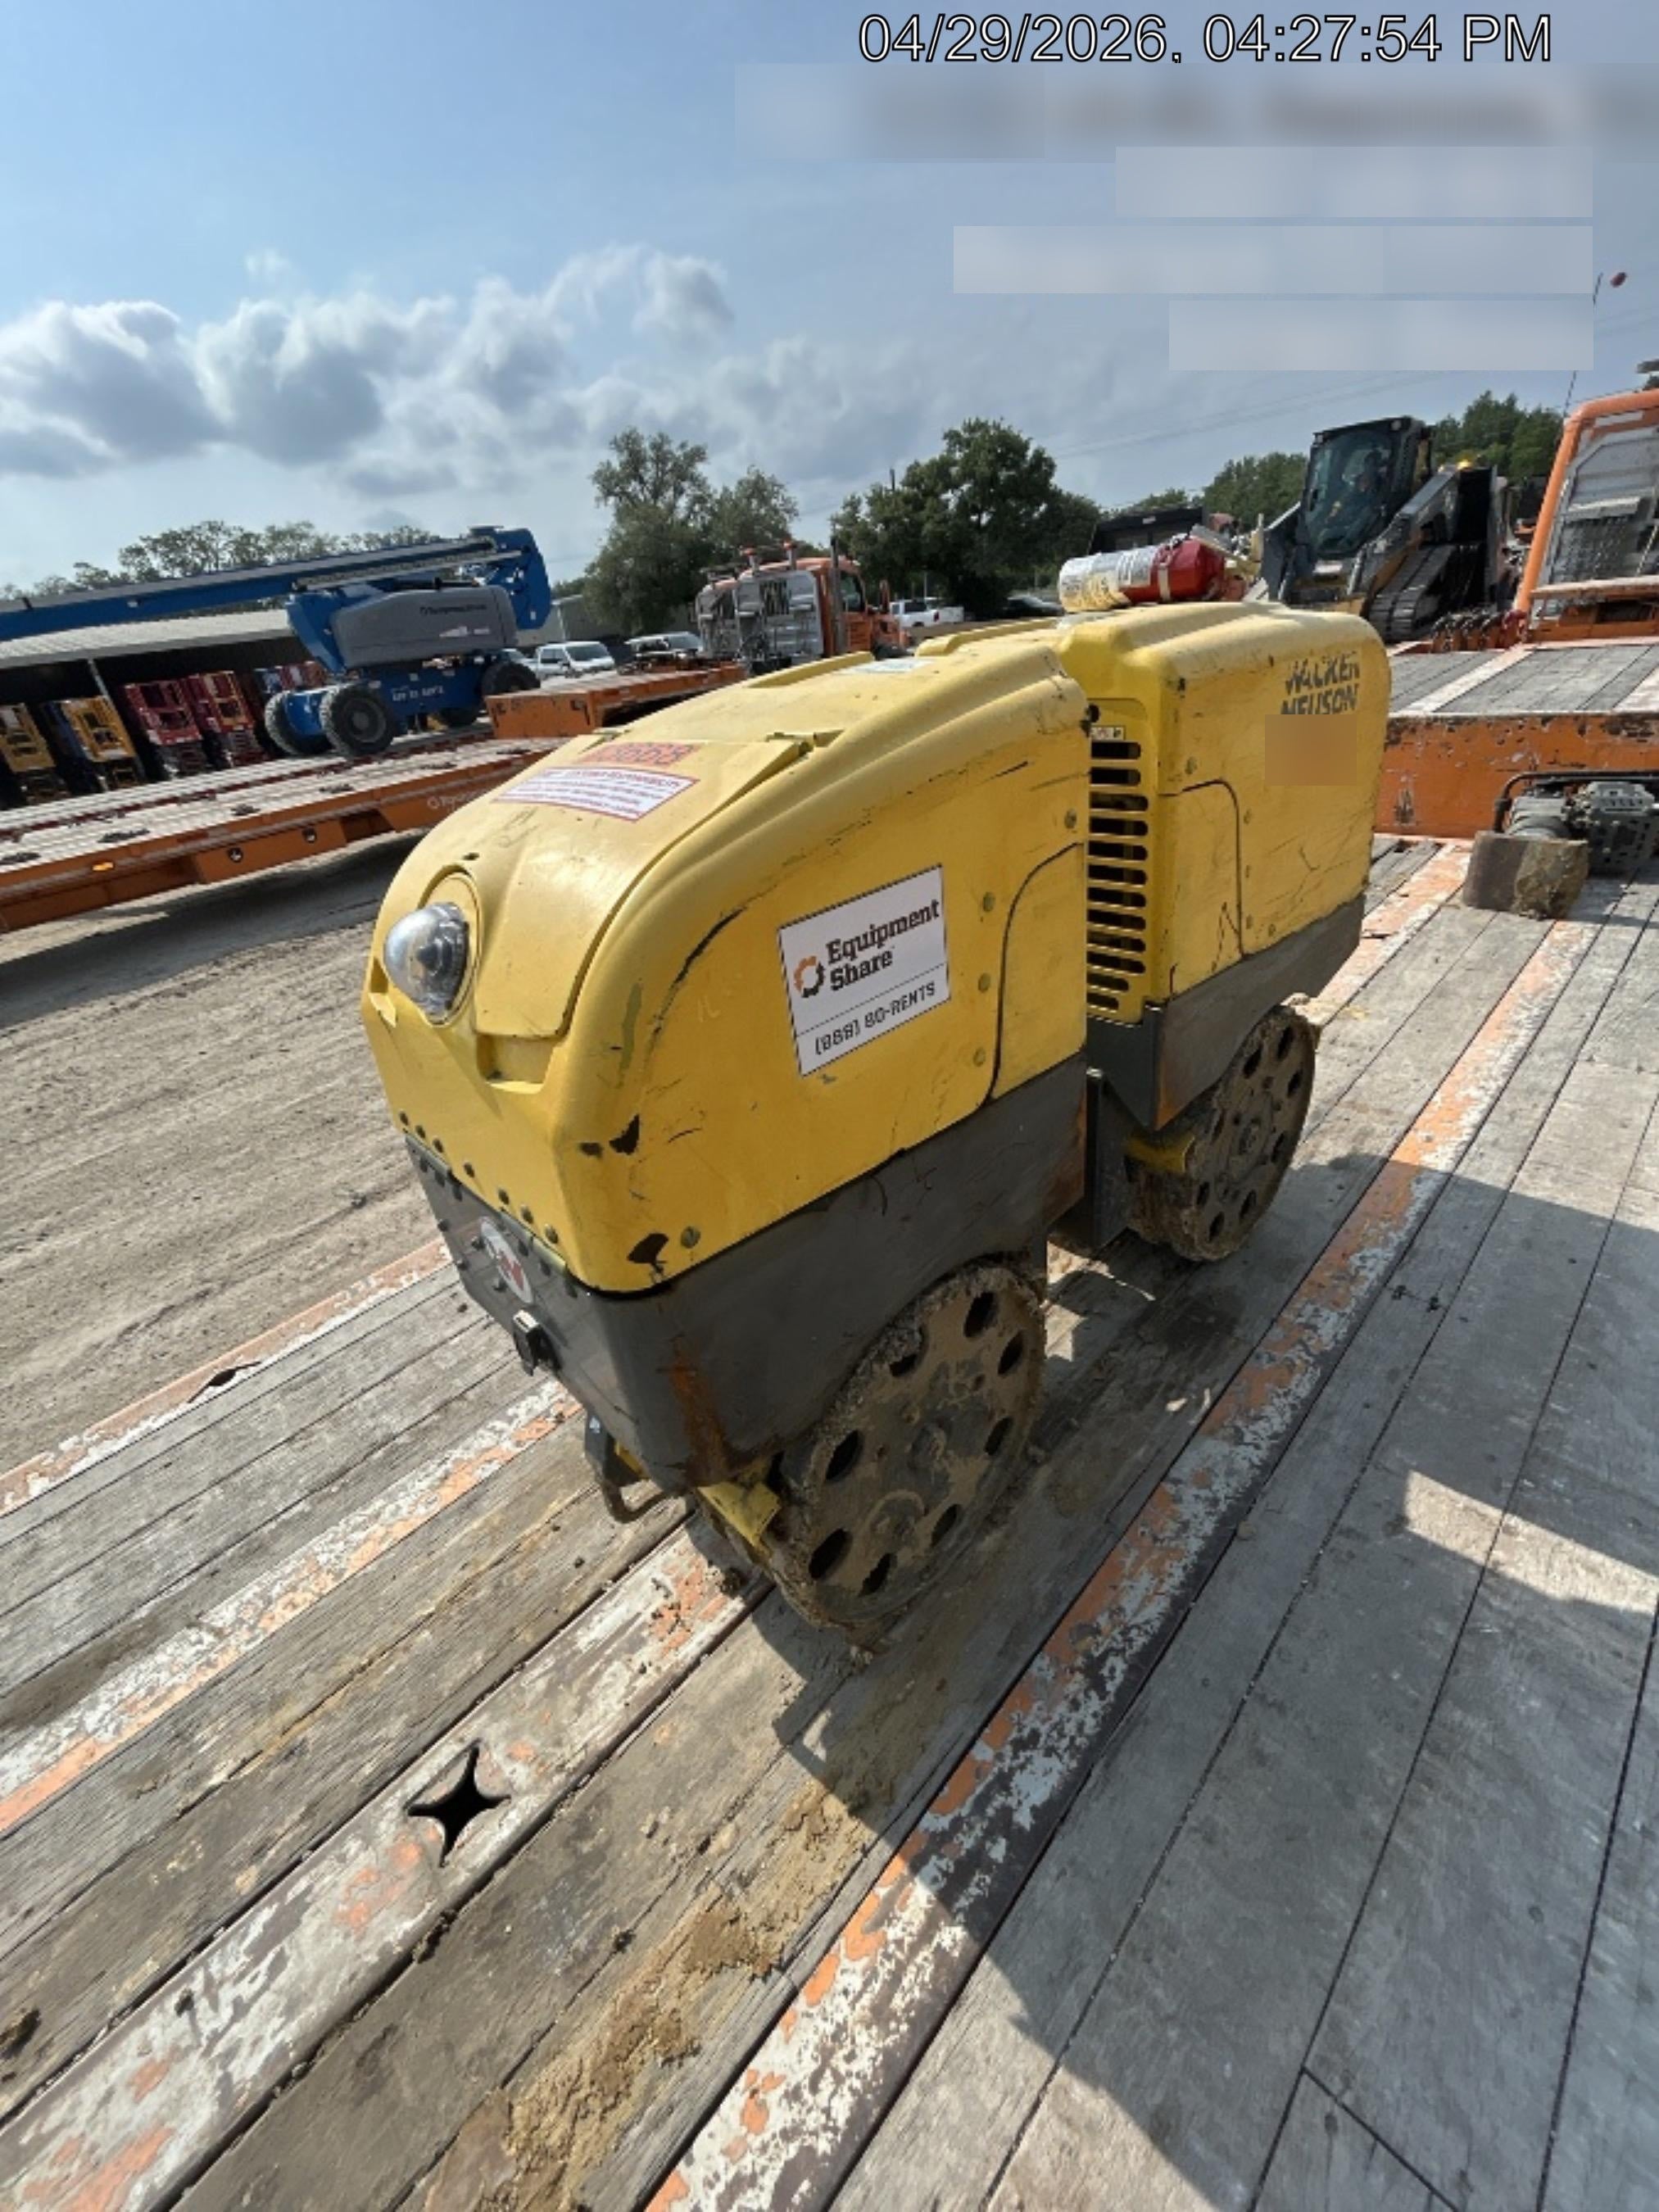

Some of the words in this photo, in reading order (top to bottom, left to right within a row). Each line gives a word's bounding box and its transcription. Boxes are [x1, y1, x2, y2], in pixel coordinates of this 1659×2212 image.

[826, 900, 940, 963] Equipment
[831, 950, 893, 990] Share
[815, 1019, 861, 1054] (888)
[864, 981, 936, 1028] 80-RENTS
